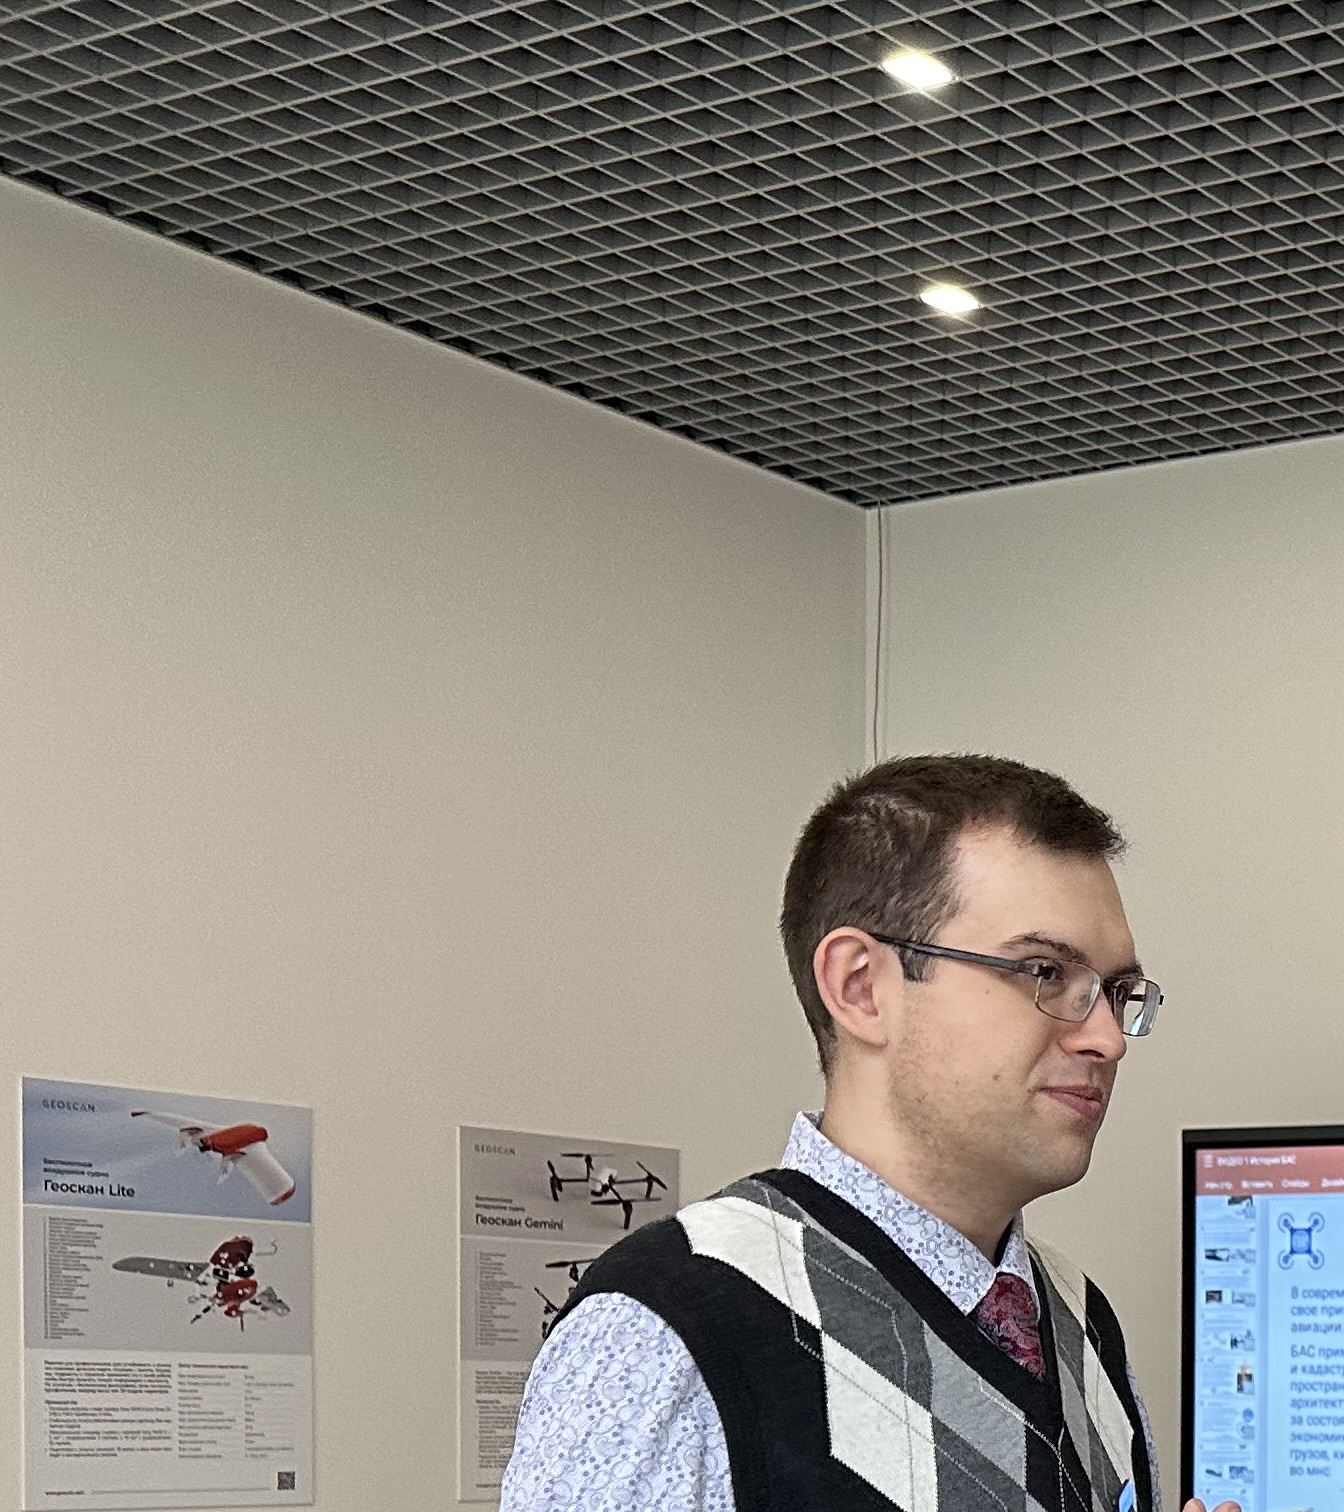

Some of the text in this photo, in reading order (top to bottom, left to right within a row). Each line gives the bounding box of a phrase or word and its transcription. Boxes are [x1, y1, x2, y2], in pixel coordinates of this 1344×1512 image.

[42, 1099, 95, 1112] GEOSCAN
[44, 1180, 135, 1197] Геоскан Lite
[475, 1214, 563, 1230] Геоскан Gemini
[1291, 1286, 1298, 1299] В
[1291, 1305, 1317, 1316] свое
[1290, 1346, 1315, 1358] БАС
[1290, 1416, 1303, 1426] за
[1290, 1449, 1330, 1462] грузов,
